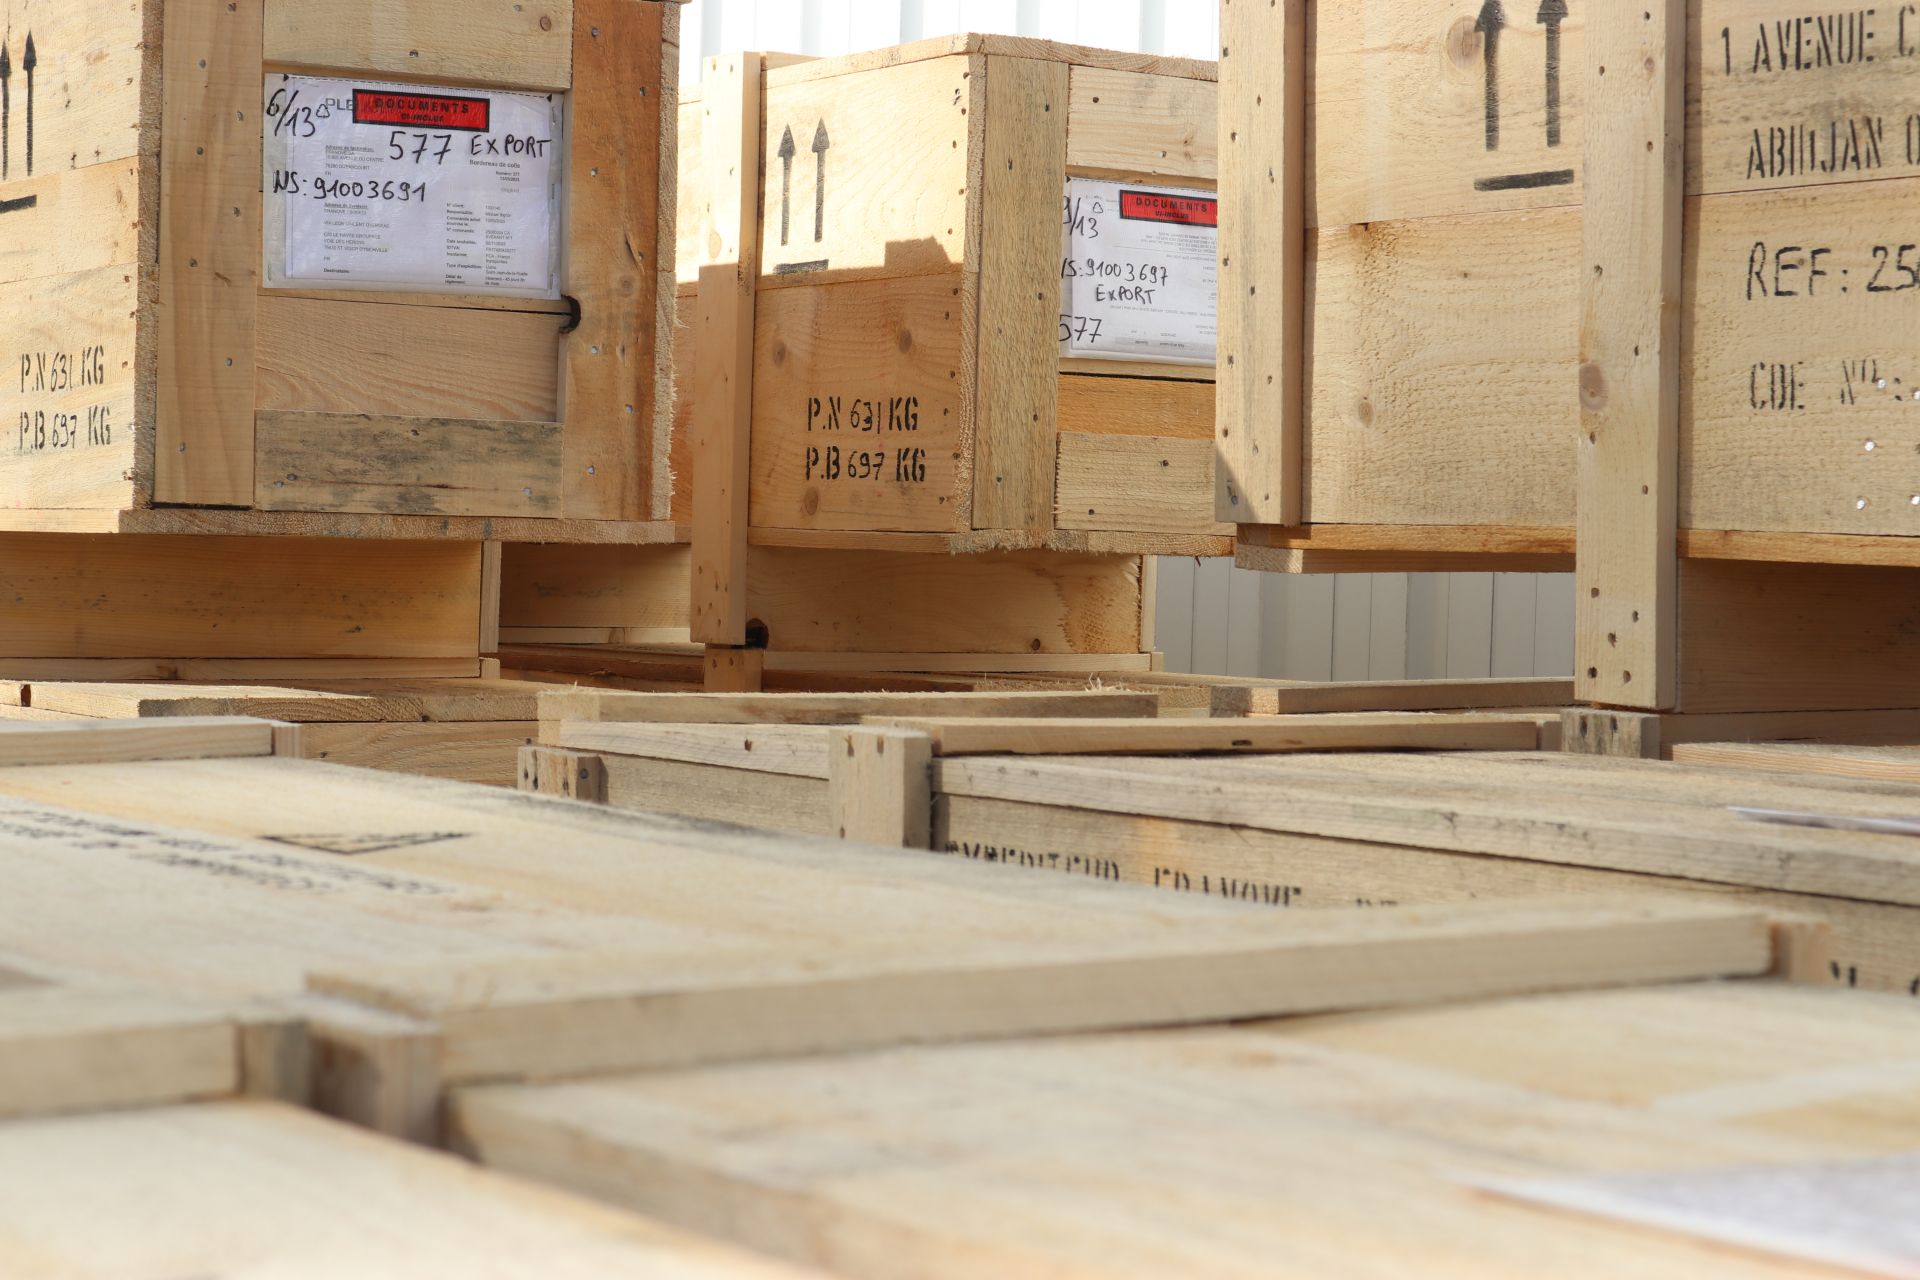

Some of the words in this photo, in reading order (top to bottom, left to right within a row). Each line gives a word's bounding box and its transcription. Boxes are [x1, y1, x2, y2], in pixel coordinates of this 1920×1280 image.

[1722, 27, 1730, 76] 1
[1753, 9, 1875, 74] AVENUE
[266, 88, 316, 138] 6/13
[374, 97, 469, 114] DOCUMENTS
[389, 131, 452, 166] 577
[470, 134, 552, 158] EXPORT
[1135, 196, 1208, 213] DOCUMENTS
[1059, 314, 1103, 344] 577
[50, 352, 73, 393] 631
[81, 345, 105, 387] KG
[20, 410, 46, 450] P.B
[52, 413, 78, 449] 697
[87, 405, 111, 447] KG
[807, 396, 841, 432] P.N
[850, 398, 881, 435] 631
[888, 396, 918, 431] KG
[805, 446, 840, 481] P.B
[848, 450, 885, 481] 697
[896, 447, 927, 482] KG
